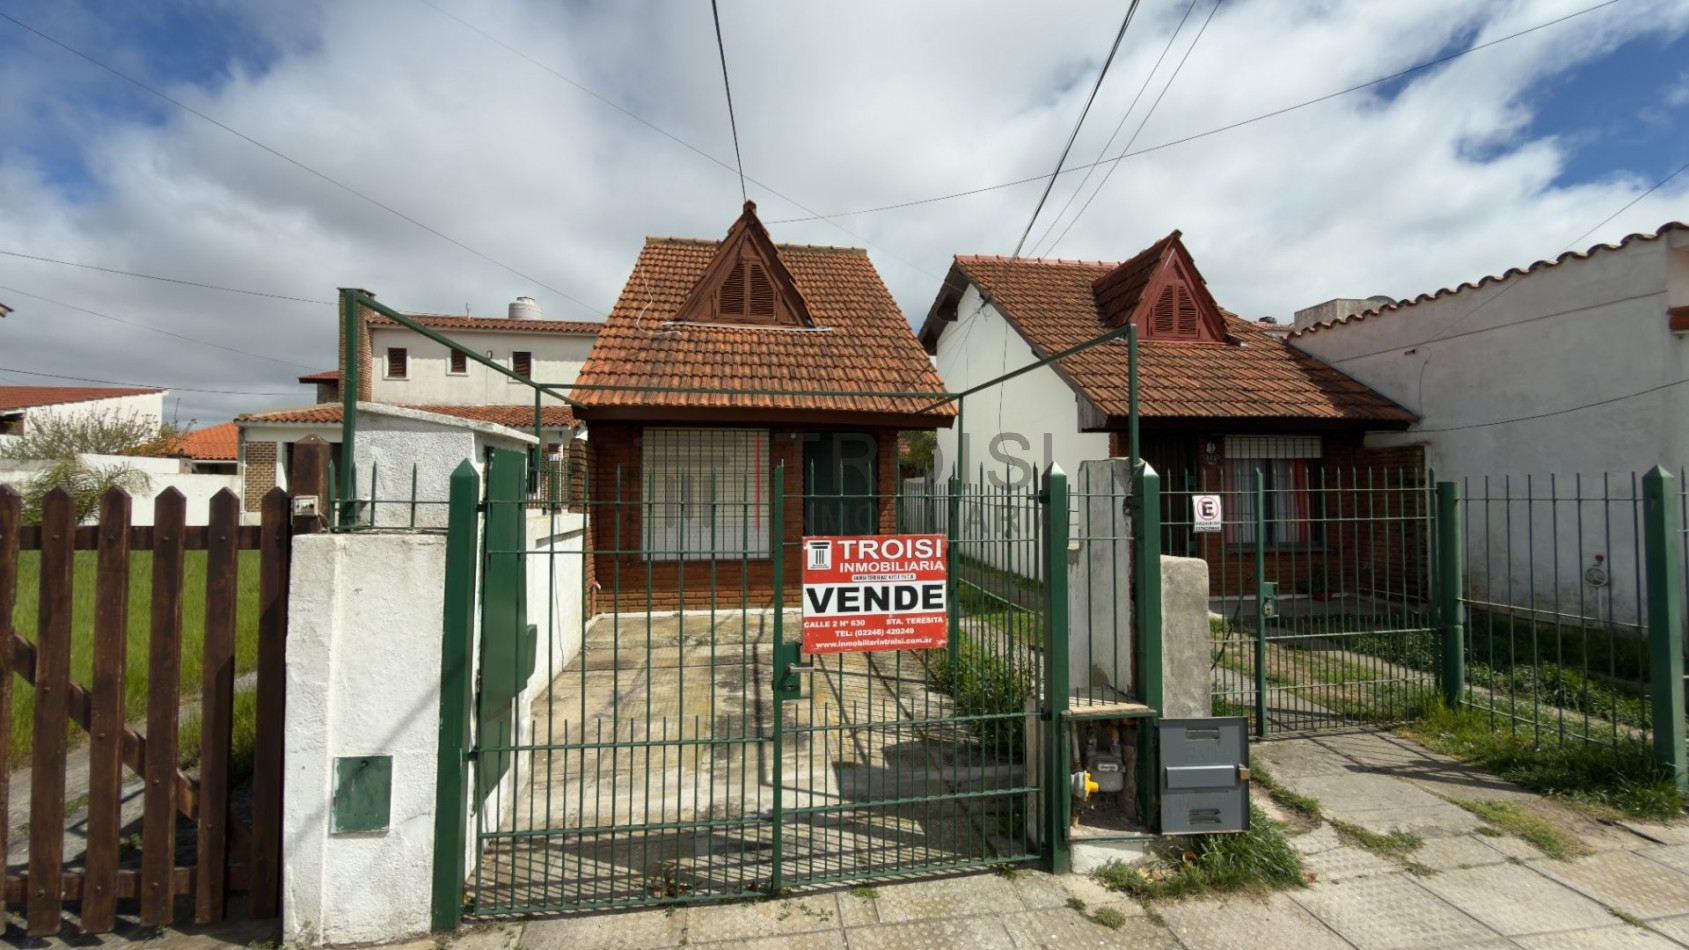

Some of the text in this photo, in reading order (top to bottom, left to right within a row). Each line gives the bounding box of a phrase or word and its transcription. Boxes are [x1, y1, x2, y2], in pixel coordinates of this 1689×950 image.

[838, 539, 942, 559] TROISI
[840, 561, 945, 573] INMOBILIARIA
[806, 584, 943, 613] VENDE
[815, 638, 932, 649] www.inmobiliariatroisi.com.ar
